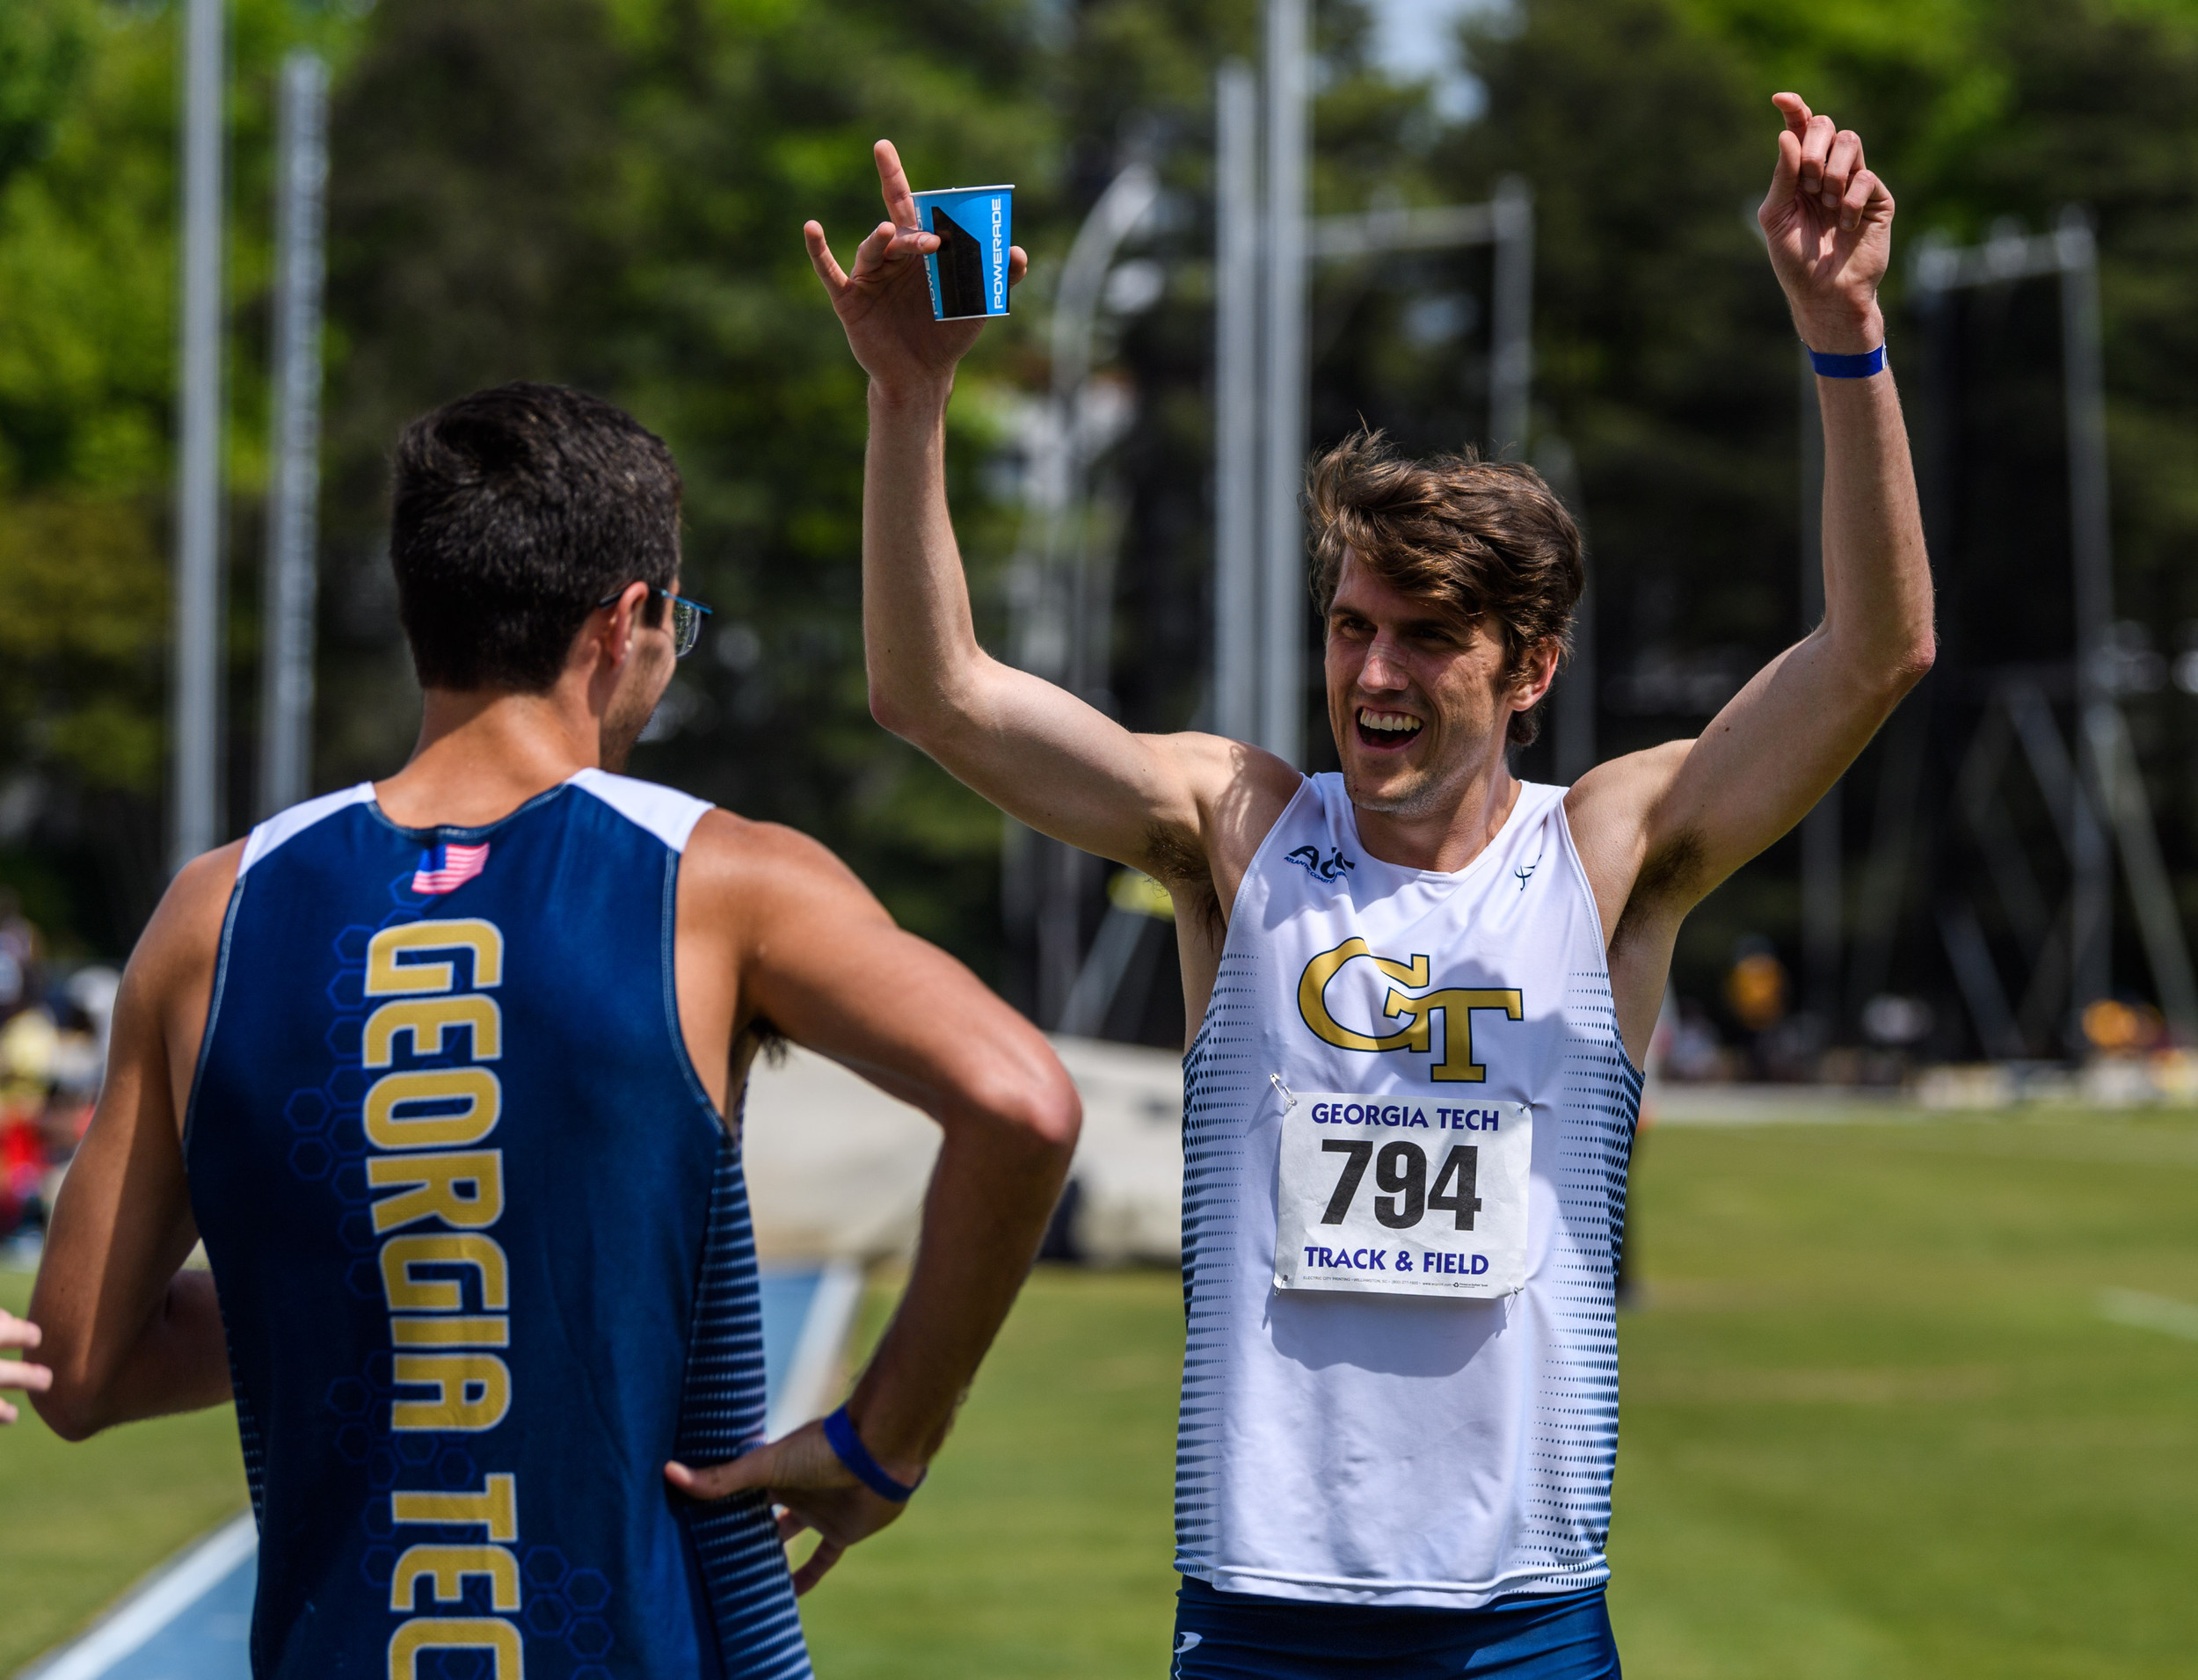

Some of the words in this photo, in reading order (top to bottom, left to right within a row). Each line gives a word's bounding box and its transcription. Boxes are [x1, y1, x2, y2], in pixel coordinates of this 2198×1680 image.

[915, 206, 938, 316] POWEDE
[991, 199, 1004, 309] POWERADE
[1284, 856, 1311, 874] ATLANTIC
[1297, 936, 1525, 1084] GT
[1311, 1102, 1430, 1129] GEORGIA
[1436, 1108, 1500, 1131] TECH
[362, 918, 512, 1433] GEORGIA
[1320, 1138, 1482, 1232] 794
[1303, 1246, 1387, 1271] TRACK
[1394, 1250, 1414, 1273] &
[1423, 1252, 1489, 1276] FIELD
[387, 1473, 525, 1680] TEC
